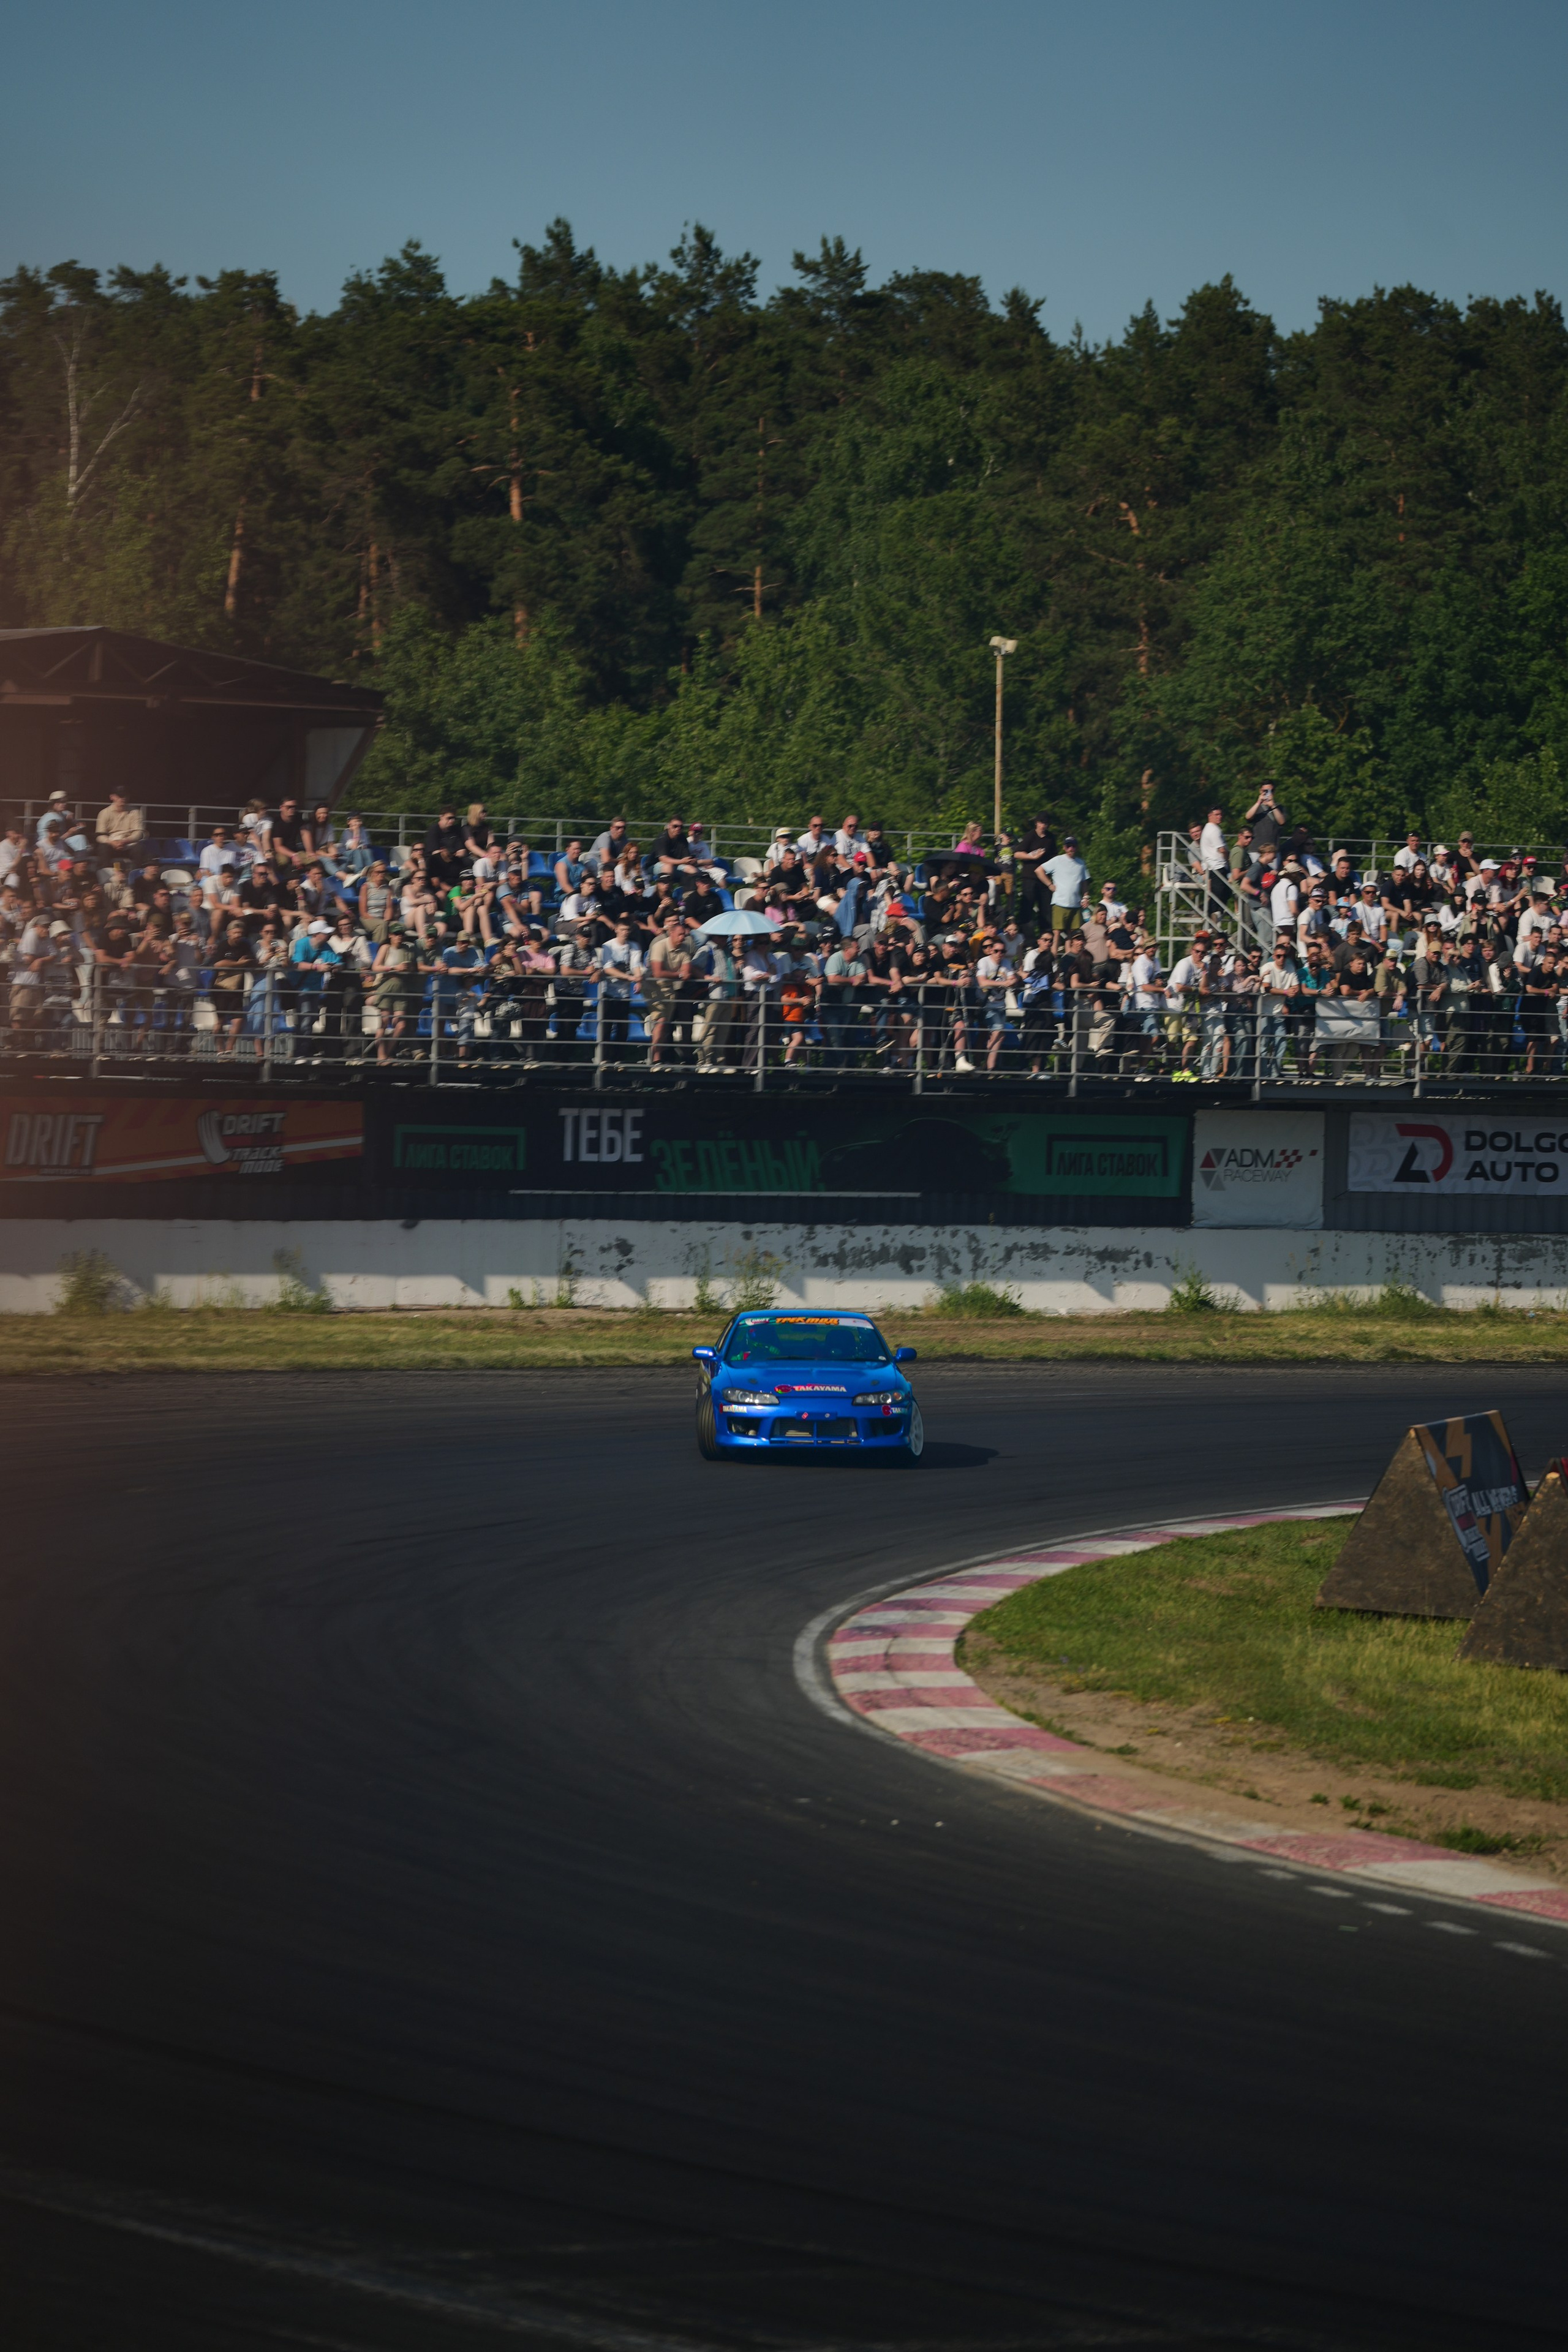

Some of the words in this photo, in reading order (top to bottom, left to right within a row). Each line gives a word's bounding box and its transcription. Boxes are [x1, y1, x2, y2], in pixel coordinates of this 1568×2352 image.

[222, 1112, 287, 1135] DRIFT
[557, 1107, 646, 1163] ТЕБЕ
[5, 1113, 104, 1166] DRIFT
[449, 1144, 515, 1170] СТАВОК
[1057, 1152, 1094, 1175] ЛИГА
[1098, 1153, 1158, 1177] СТАВОК
[1224, 1148, 1275, 1168] ADM
[1223, 1169, 1292, 1182] RACEWAY
[1464, 1161, 1559, 1182] AUTO
